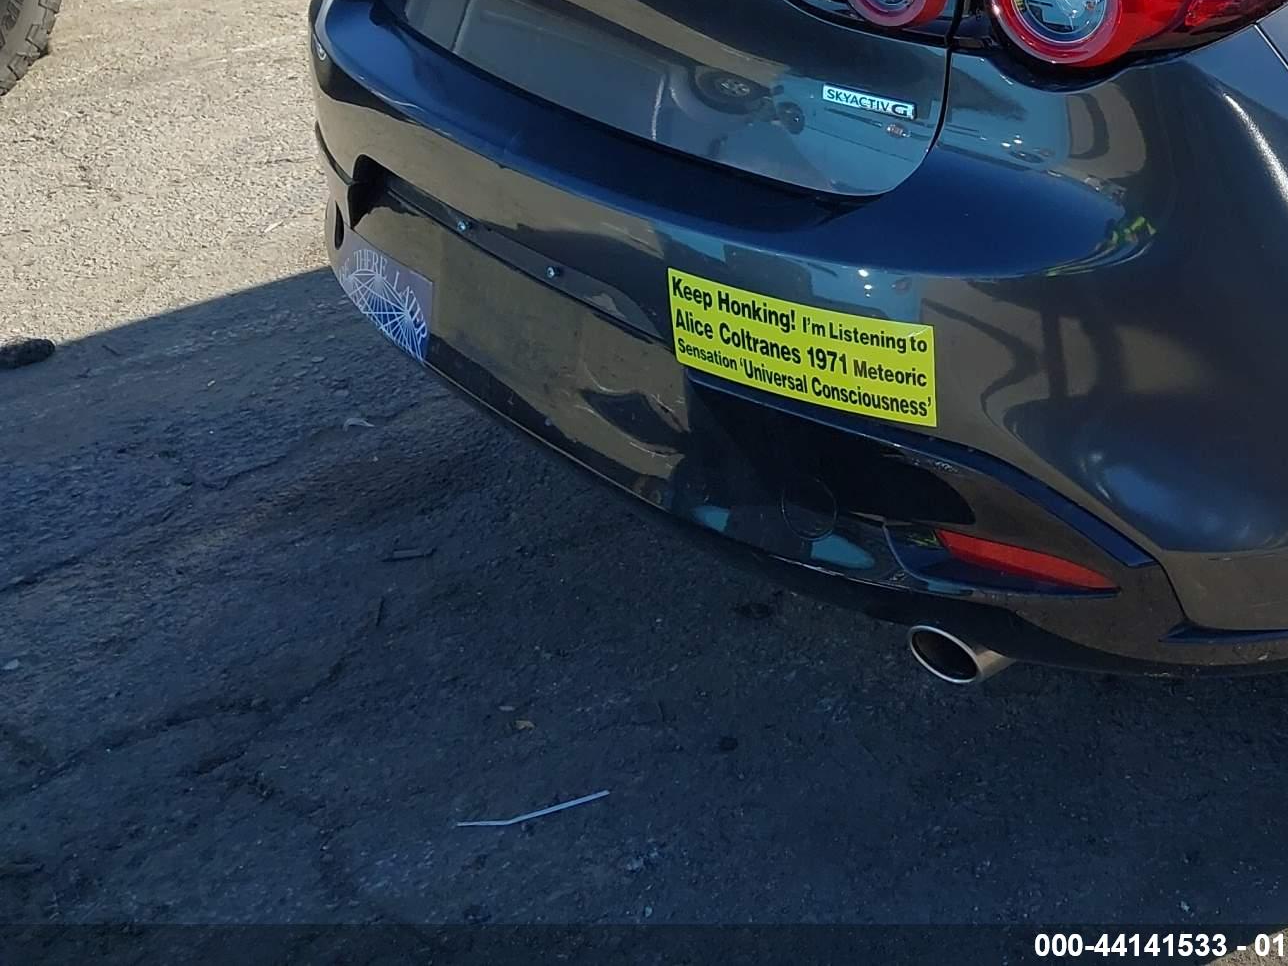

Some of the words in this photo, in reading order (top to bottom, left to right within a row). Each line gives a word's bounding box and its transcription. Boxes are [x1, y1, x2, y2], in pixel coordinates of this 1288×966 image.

[672, 275, 713, 310] Keep
[718, 290, 796, 334] Honking!
[802, 316, 826, 338] I'm
[829, 321, 907, 354] Listening
[910, 335, 928, 353] to
[676, 308, 713, 340] Alice
[719, 322, 801, 364] Coltranes
[807, 346, 847, 375] 1971
[853, 359, 927, 387] Meteoric
[678, 337, 738, 371] Sensation
